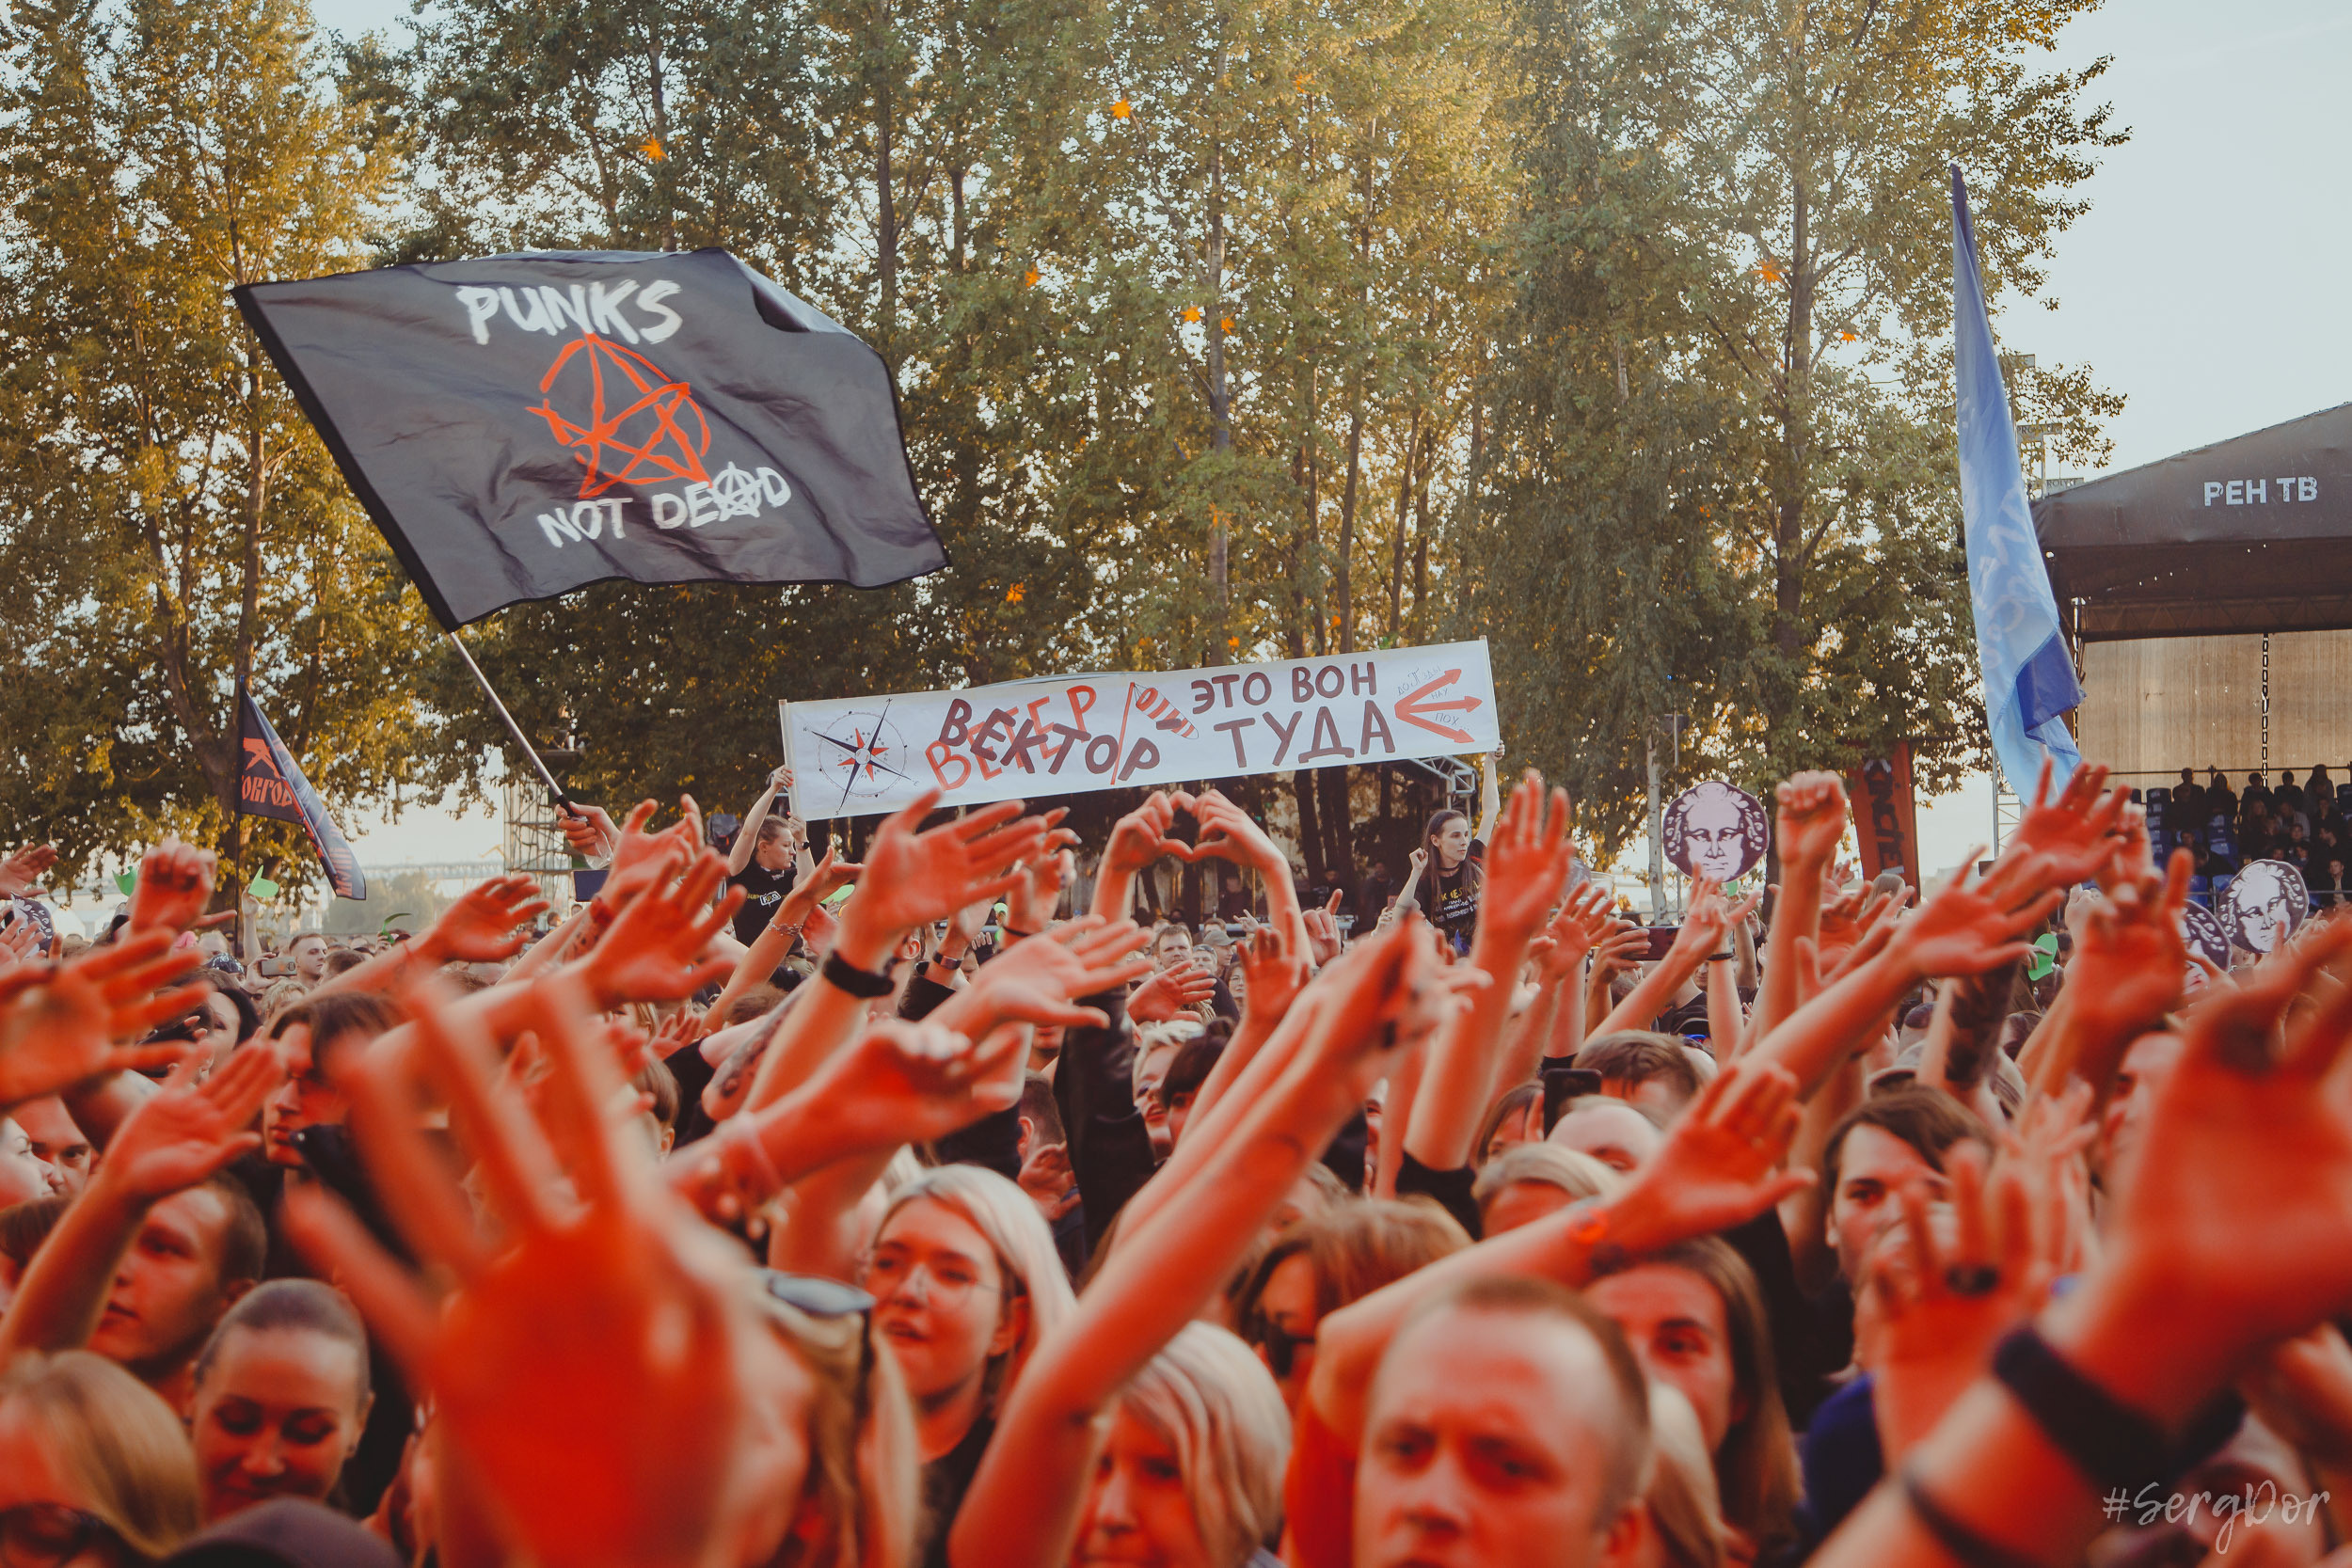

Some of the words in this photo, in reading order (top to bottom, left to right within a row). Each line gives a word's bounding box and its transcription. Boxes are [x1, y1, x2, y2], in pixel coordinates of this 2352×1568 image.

[455, 279, 683, 345] PUNKS
[536, 497, 634, 548] NOT
[651, 463, 792, 531] DEAD
[2203, 478, 2267, 507] РЕН
[2276, 476, 2318, 503] ТВ
[1190, 673, 1272, 715] ЭТО
[1292, 661, 1377, 704] ВОН
[940, 698, 1161, 782] ВЕКТОР
[1214, 700, 1396, 768] ТУДА
